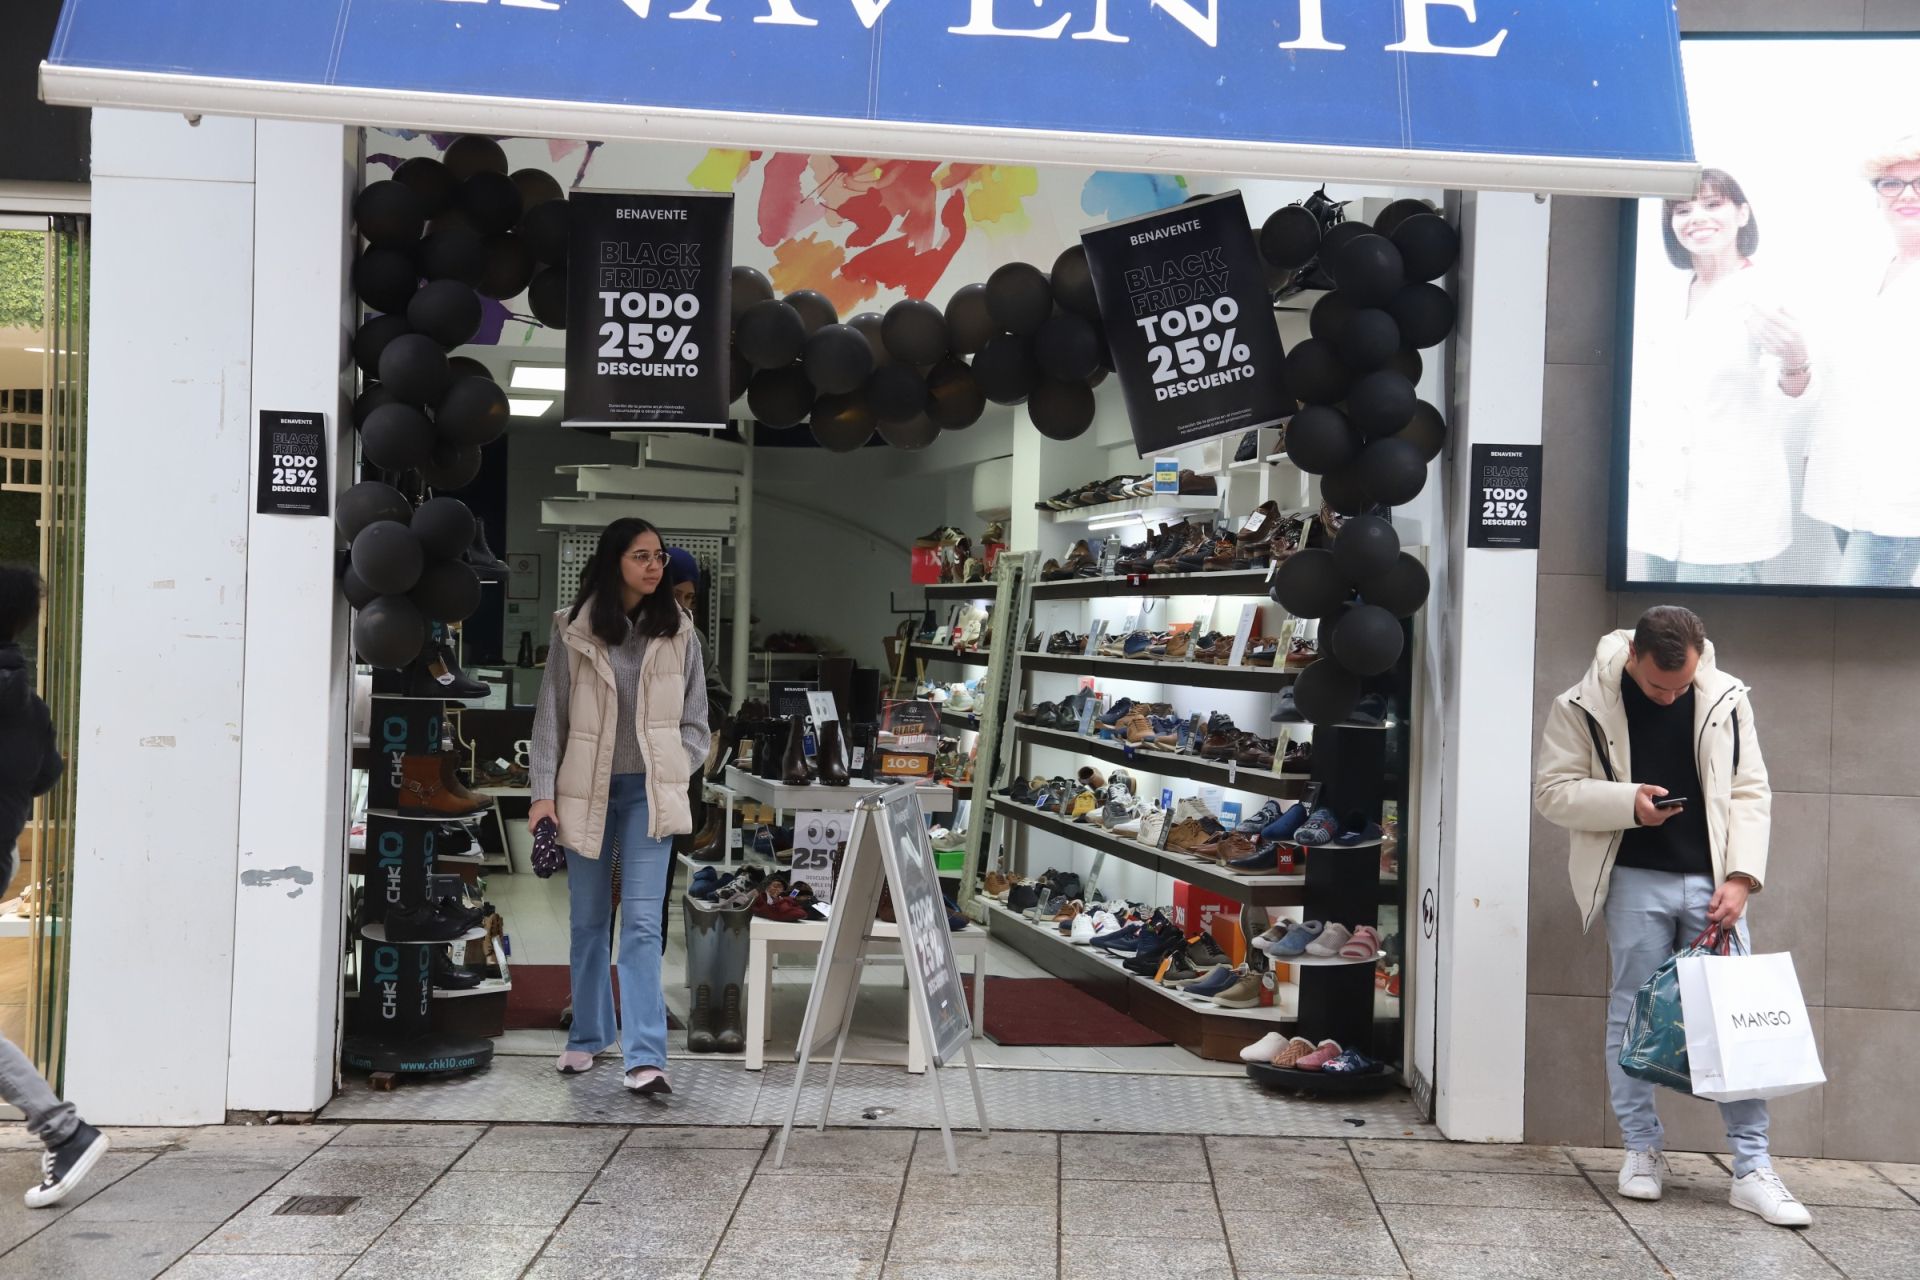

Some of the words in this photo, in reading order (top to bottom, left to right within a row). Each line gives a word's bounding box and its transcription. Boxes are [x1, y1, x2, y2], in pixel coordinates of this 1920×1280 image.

[616, 208, 688, 220] BENAVENTE
[1129, 219, 1201, 246] BENAVENTE
[599, 241, 701, 267] BLACK
[599, 267, 700, 290] FRIDAY
[1124, 247, 1228, 294] BLACK
[1131, 271, 1230, 317] FRIDAY
[598, 291, 700, 320] TODO
[1136, 296, 1239, 343] TODO
[598, 321, 699, 361] 25%
[1147, 327, 1251, 385] 25%
[597, 362, 699, 378] DESCUENTO
[1155, 364, 1255, 401] DESCUENTO
[273, 432, 318, 445] BLACK
[273, 444, 318, 455] FRIDAY
[272, 454, 318, 468] TODO
[272, 468, 317, 486] 25%
[1483, 465, 1528, 477] BLACK
[271, 485, 317, 493] DESCUENTO
[1482, 477, 1528, 488] FRIDAY
[1482, 488, 1528, 500] TODO
[1482, 501, 1528, 519] 25%
[893, 723, 924, 736] BLACK
[898, 733, 927, 745] FRIDAY
[383, 716, 408, 788] CHK10
[887, 758, 920, 769] 10€
[379, 831, 403, 903] CHK10
[373, 945, 399, 1019] CHK10
[1731, 1010, 1791, 1029] MANGO
[400, 1056, 475, 1071] www.chk10.com
